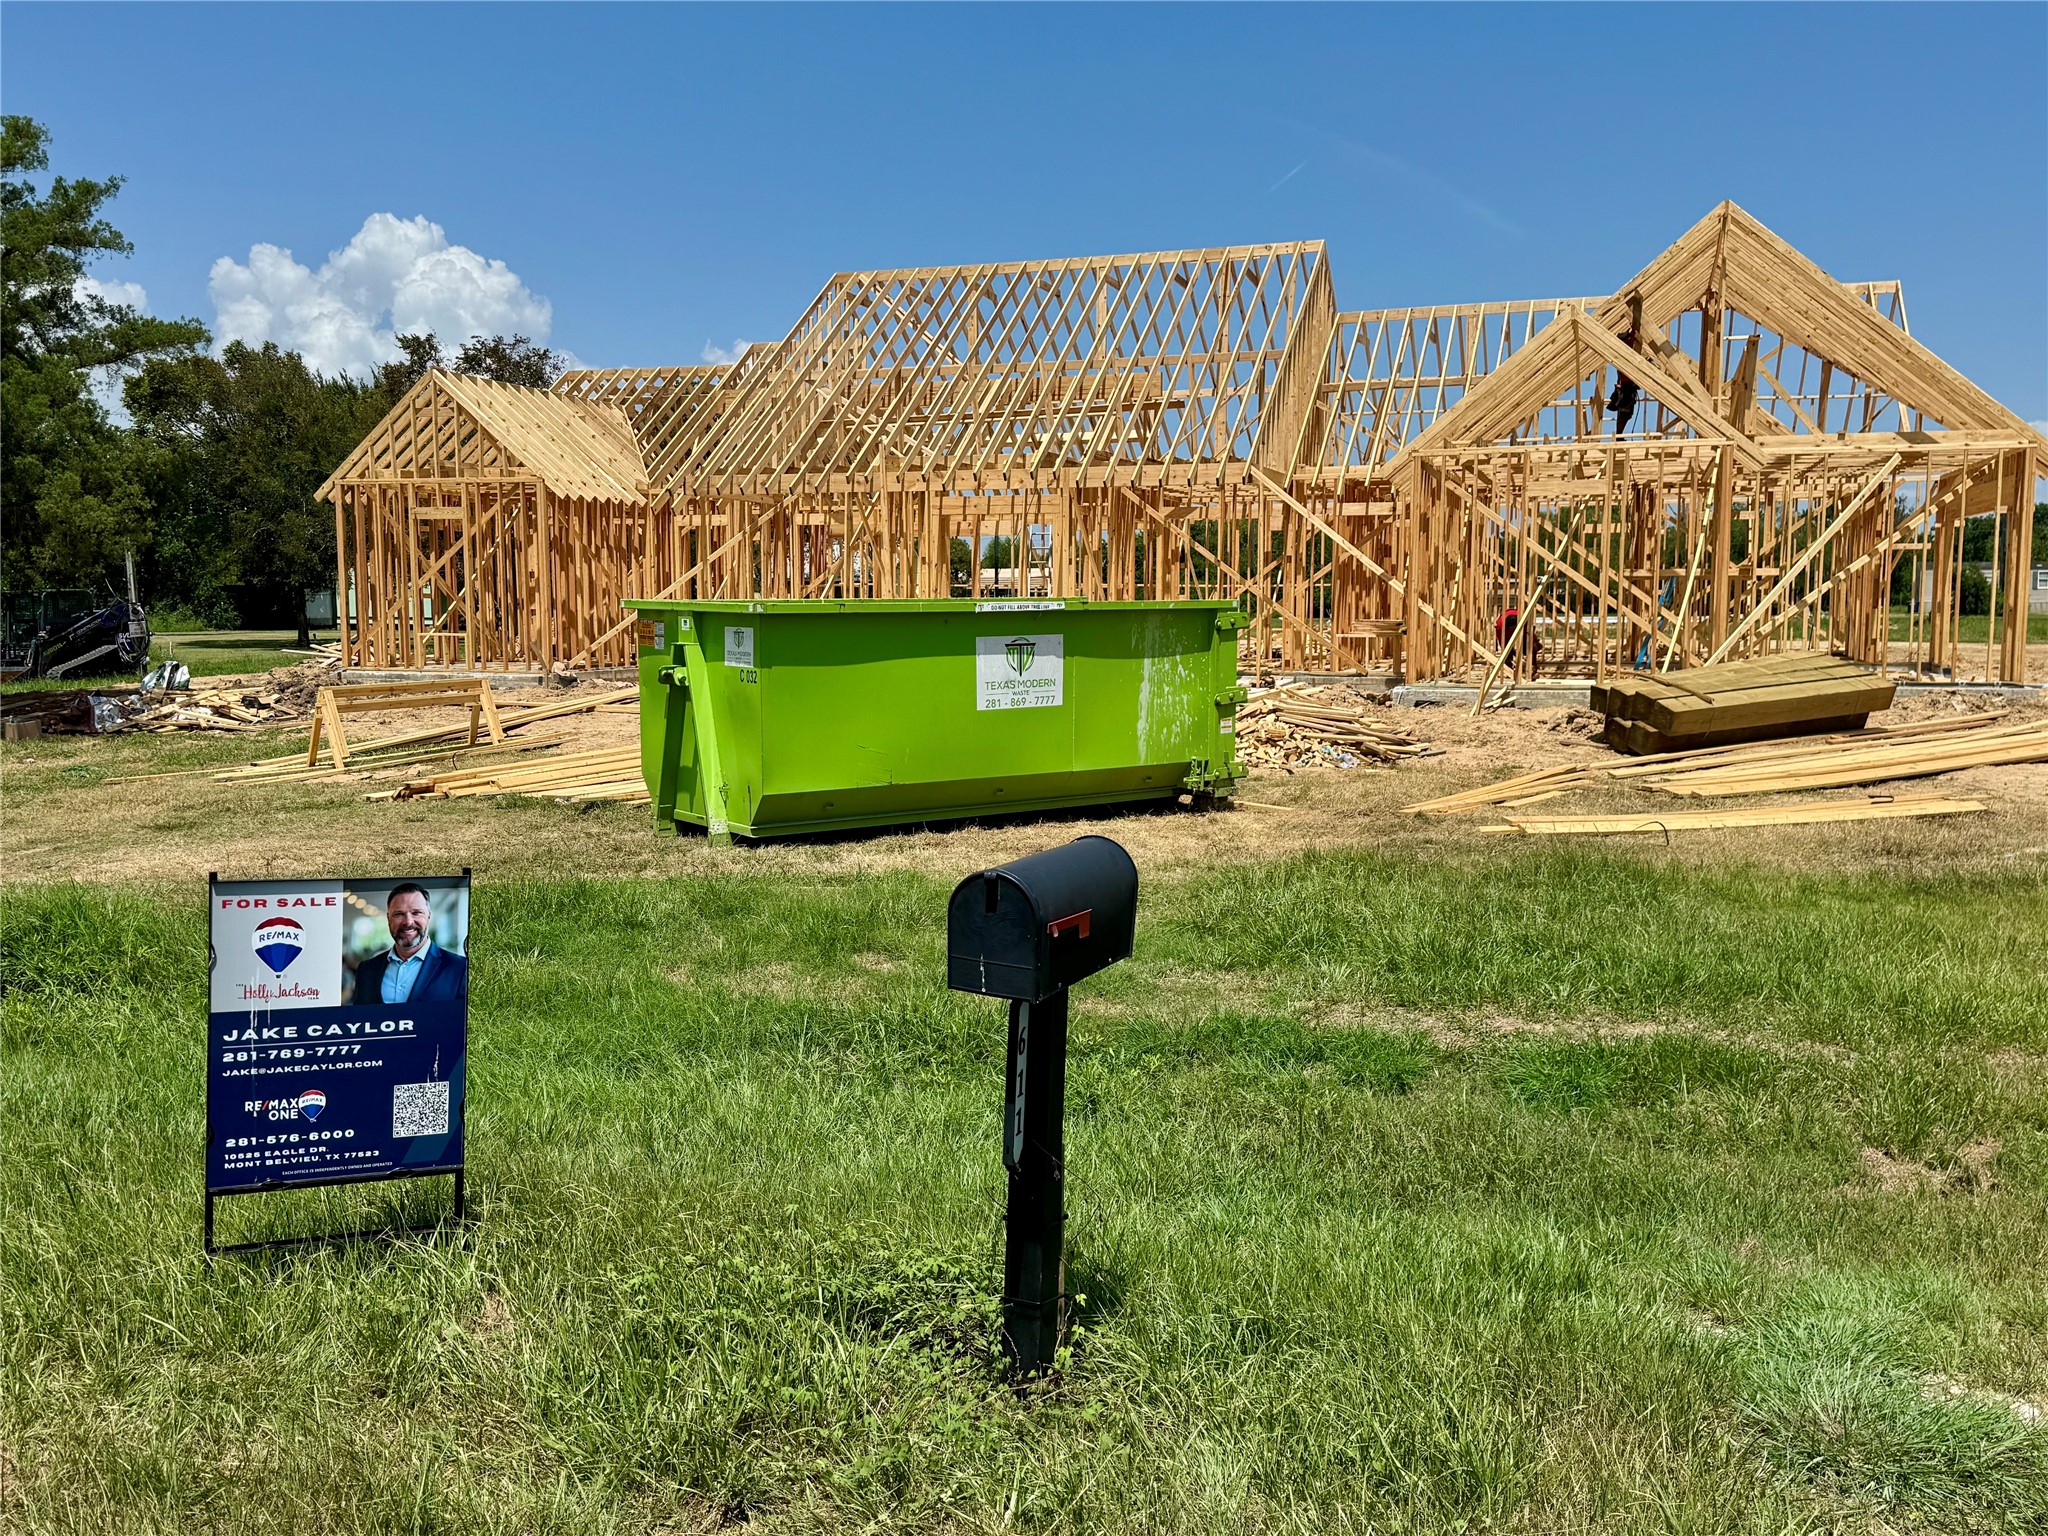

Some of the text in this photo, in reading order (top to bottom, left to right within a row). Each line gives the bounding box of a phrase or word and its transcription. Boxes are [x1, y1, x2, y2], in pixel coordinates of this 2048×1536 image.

[740, 669, 758, 684] C 032
[985, 678, 1056, 690] TEXAS MODERN
[986, 699, 1001, 708] 281
[1010, 697, 1026, 707] 869
[1034, 696, 1056, 705] 7777
[222, 897, 336, 909] FOR SALE
[259, 931, 300, 942] RE/MAX
[274, 982, 320, 999] Jackson
[222, 1020, 414, 1042] JAKE CAYLOR
[222, 1044, 362, 1062] 281-769-7777
[222, 1060, 382, 1076] JAKE@JAKECAYLOR.COM
[244, 1098, 298, 1112] RE/MAX
[268, 1109, 298, 1120] ONE
[225, 1129, 354, 1148] 281-576-6000
[264, 1148, 306, 1157] EAGLE
[224, 1160, 262, 1170] MONT
[344, 1150, 380, 1158] 77523
